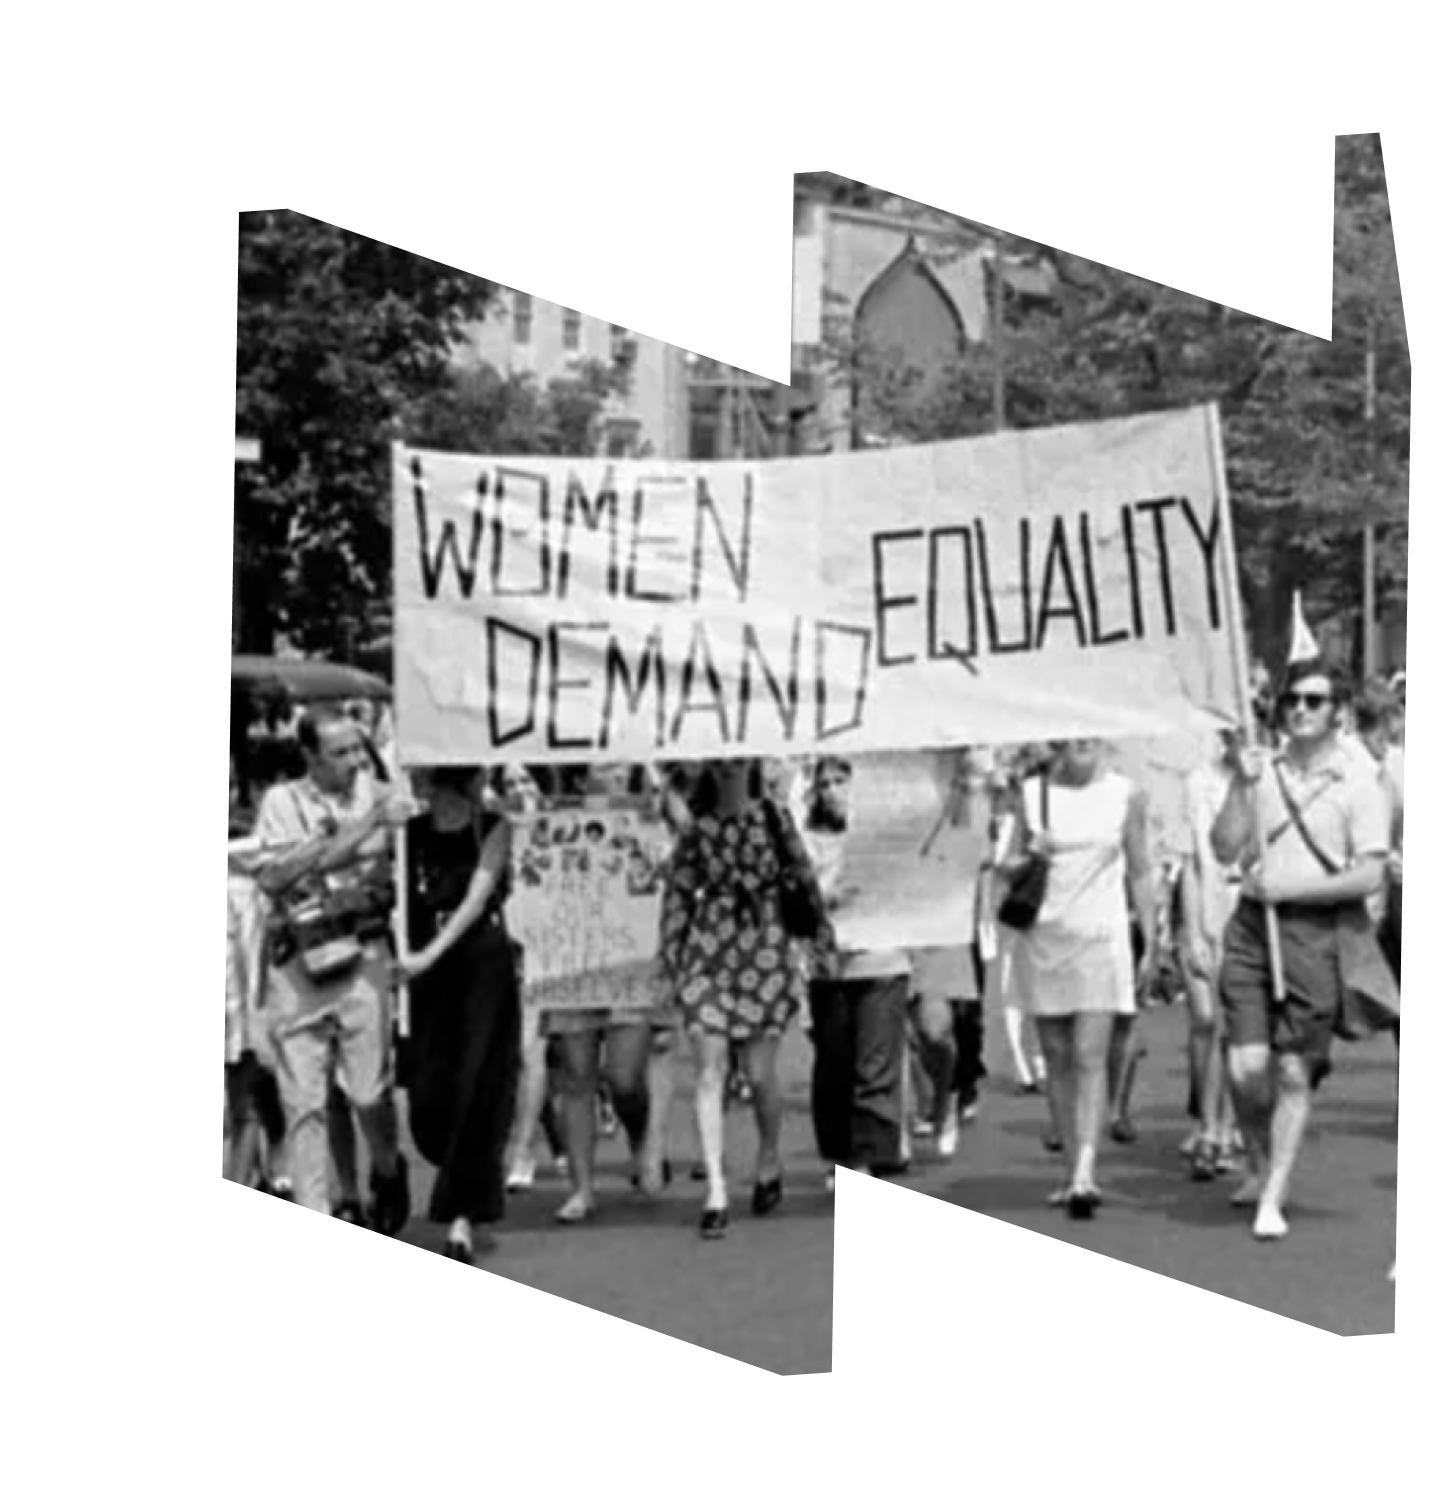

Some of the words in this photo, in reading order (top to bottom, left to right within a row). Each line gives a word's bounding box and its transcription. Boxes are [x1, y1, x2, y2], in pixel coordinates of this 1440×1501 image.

[411, 456, 752, 602] WOMEN
[872, 496, 1221, 676] EQUALITY
[486, 616, 871, 748] DEMAND
